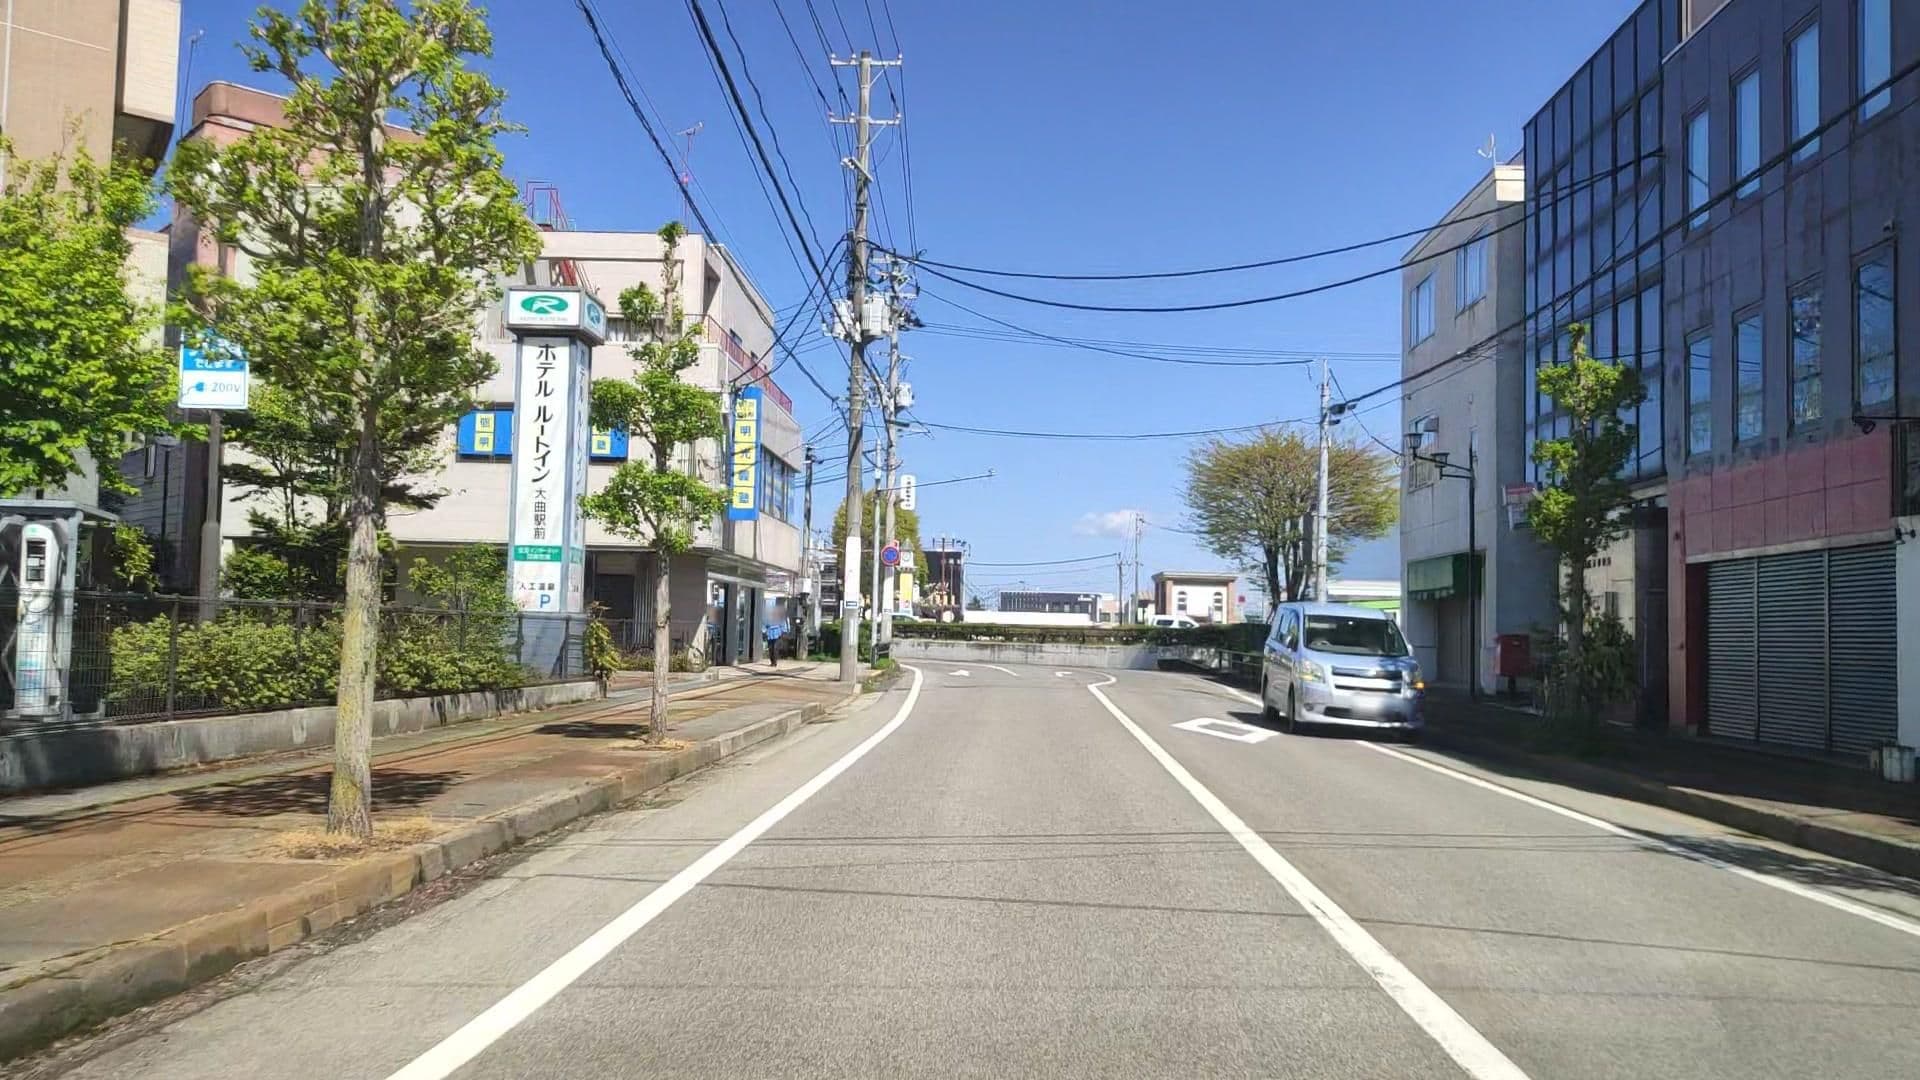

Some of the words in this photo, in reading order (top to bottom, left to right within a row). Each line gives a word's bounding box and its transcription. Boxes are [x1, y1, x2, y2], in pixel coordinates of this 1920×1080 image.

[535, 344, 556, 397] ホテル
[531, 405, 554, 482] ルートイン
[534, 489, 546, 539] 大曲駅前
[540, 594, 551, 608] P
